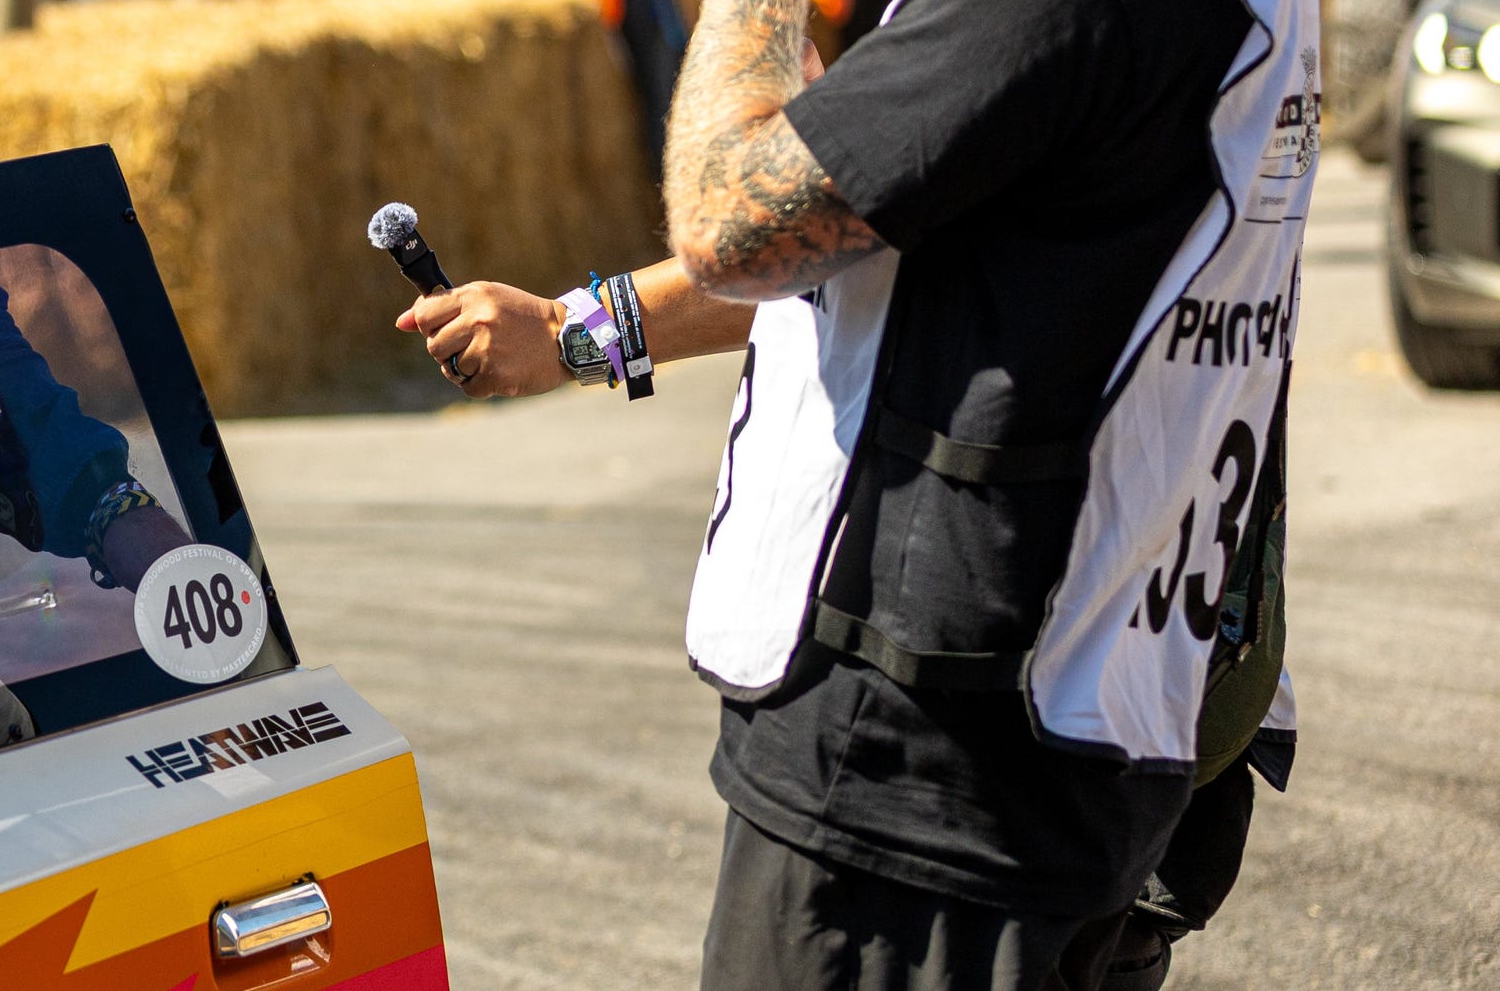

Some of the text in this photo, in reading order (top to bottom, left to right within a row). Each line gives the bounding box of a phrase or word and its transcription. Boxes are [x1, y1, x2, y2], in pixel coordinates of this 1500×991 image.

[183, 548, 223, 561] FESTIVAL
[225, 555, 238, 567] OF
[163, 572, 243, 650] 408
[222, 627, 263, 676] MASTERCARD
[125, 701, 353, 790] HEATWAVE
